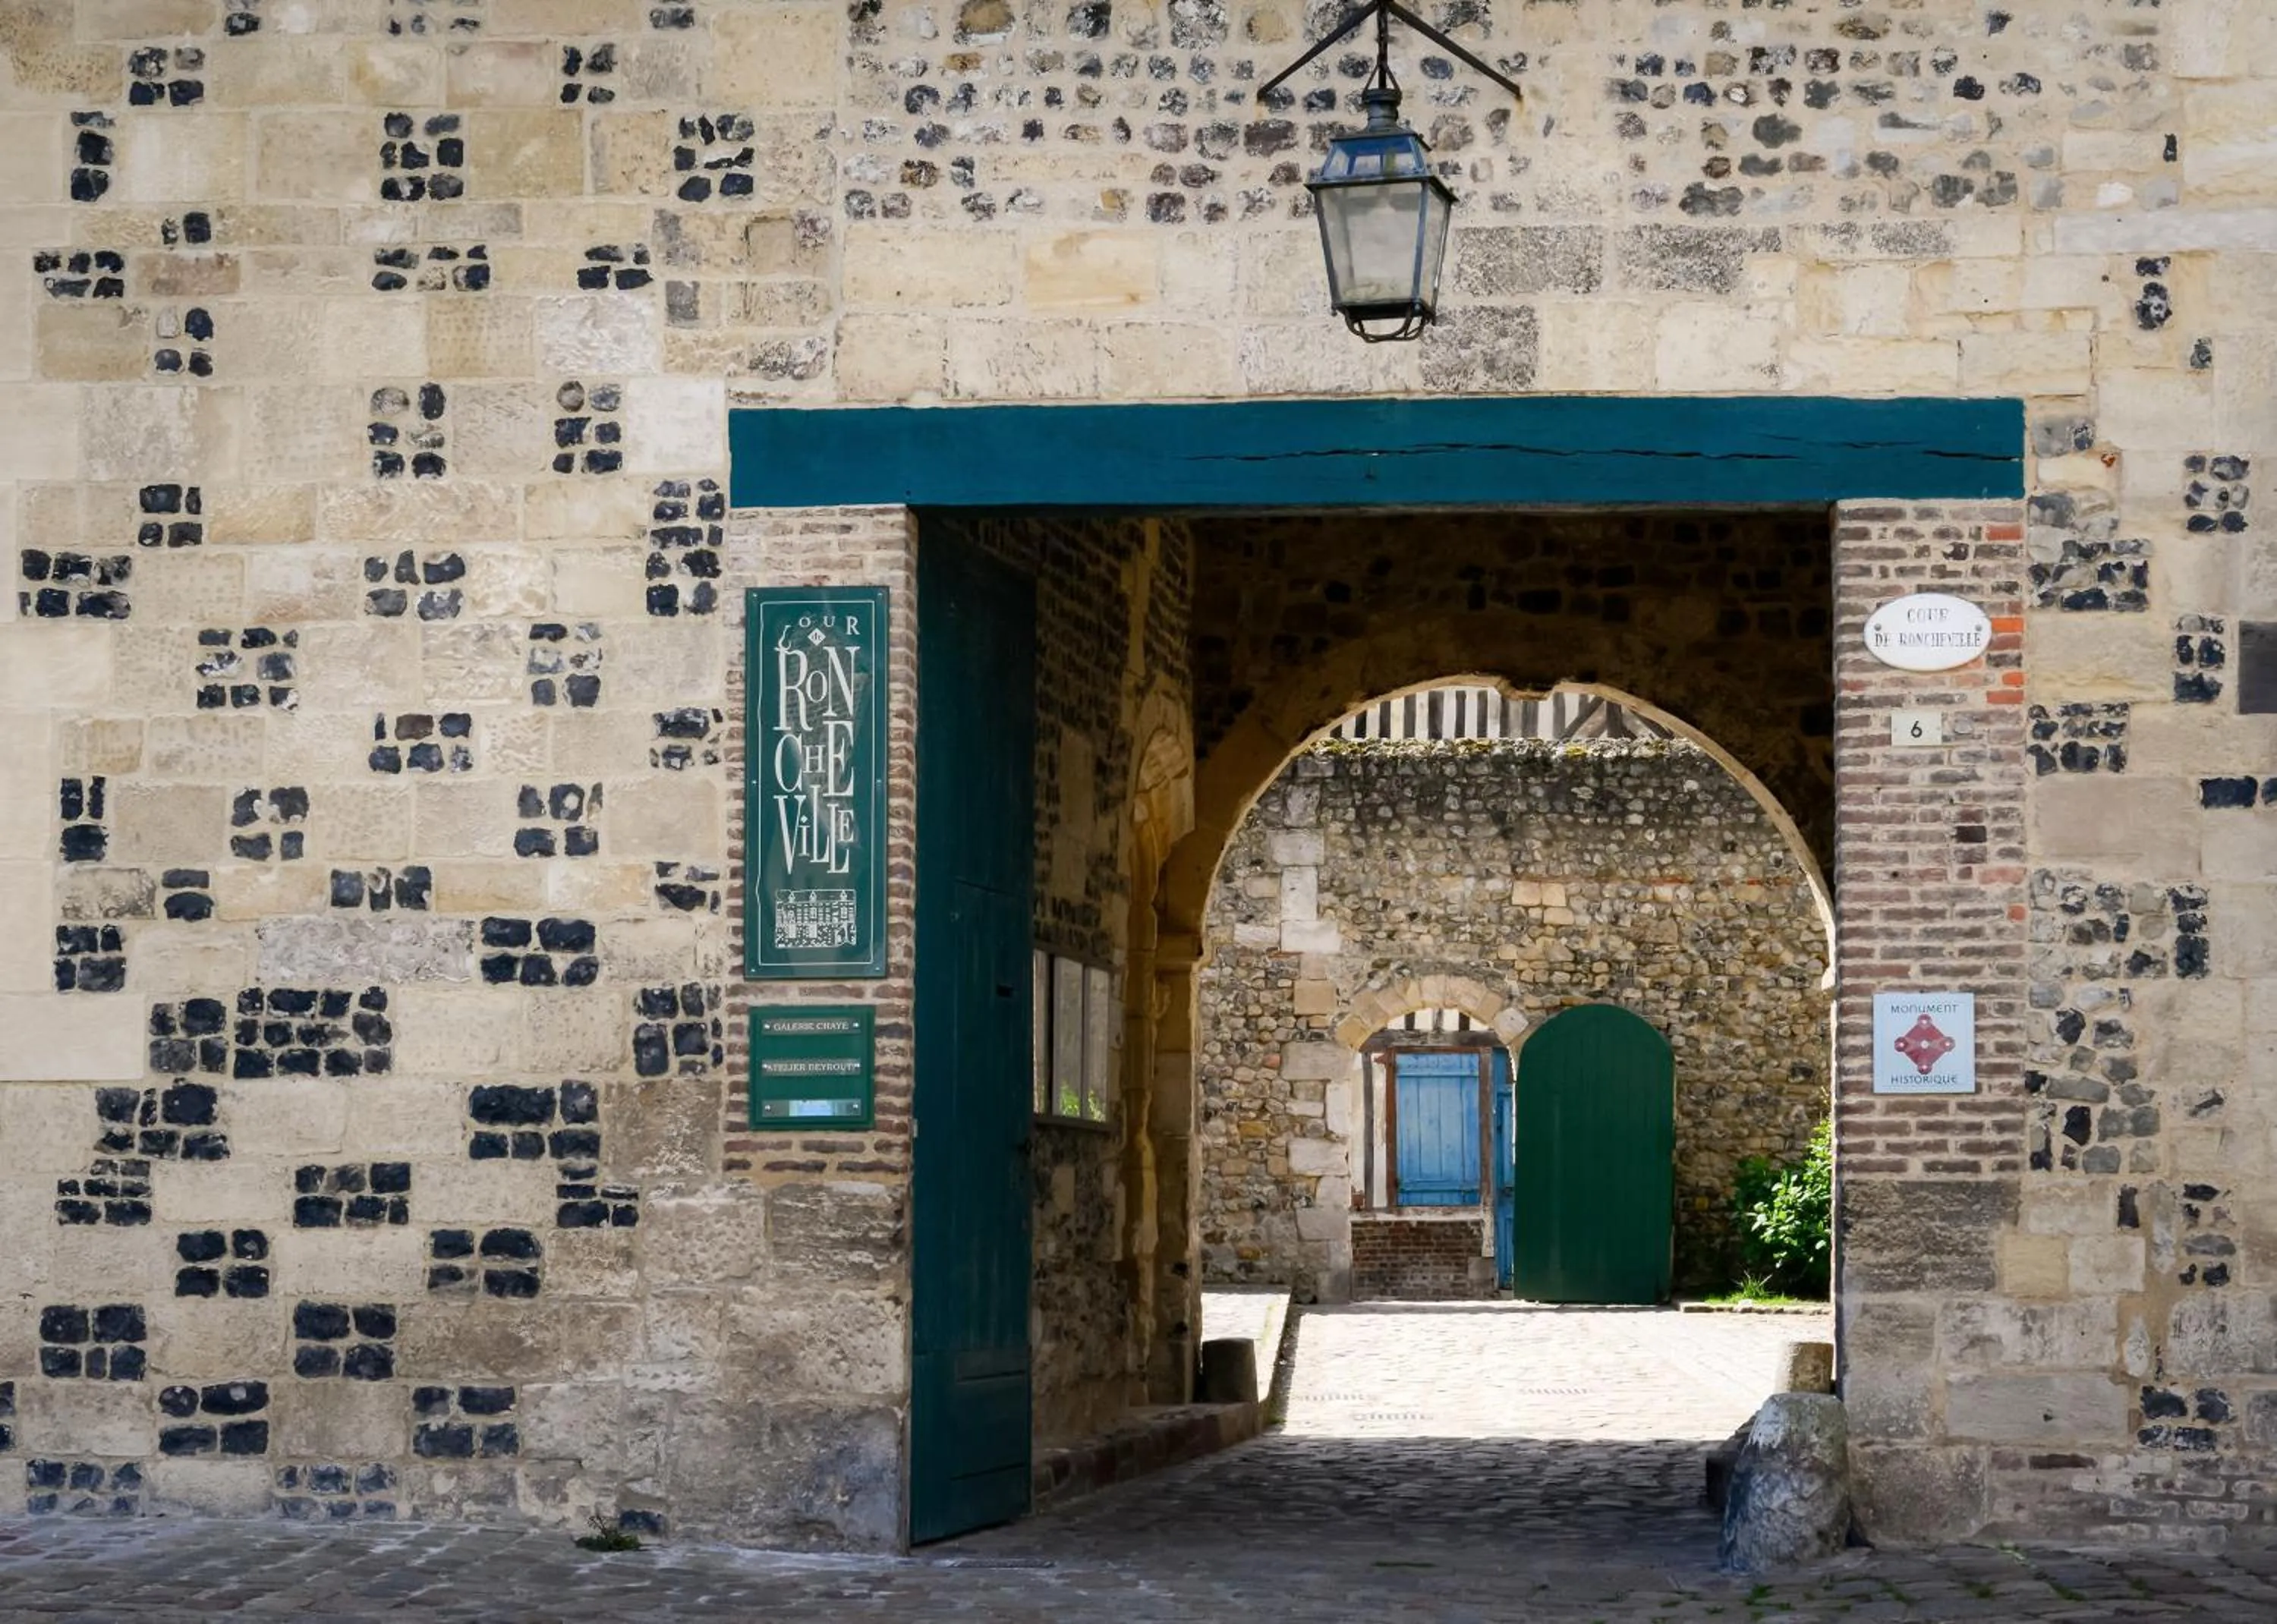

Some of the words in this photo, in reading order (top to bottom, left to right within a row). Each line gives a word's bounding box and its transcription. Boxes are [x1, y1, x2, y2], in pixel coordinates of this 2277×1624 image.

[1875, 633, 1891, 647] DE
[1910, 720, 1923, 738] 6
[1891, 1004, 1959, 1014] MONUMENT
[1891, 1074, 1957, 1085] HISTORIQUE
